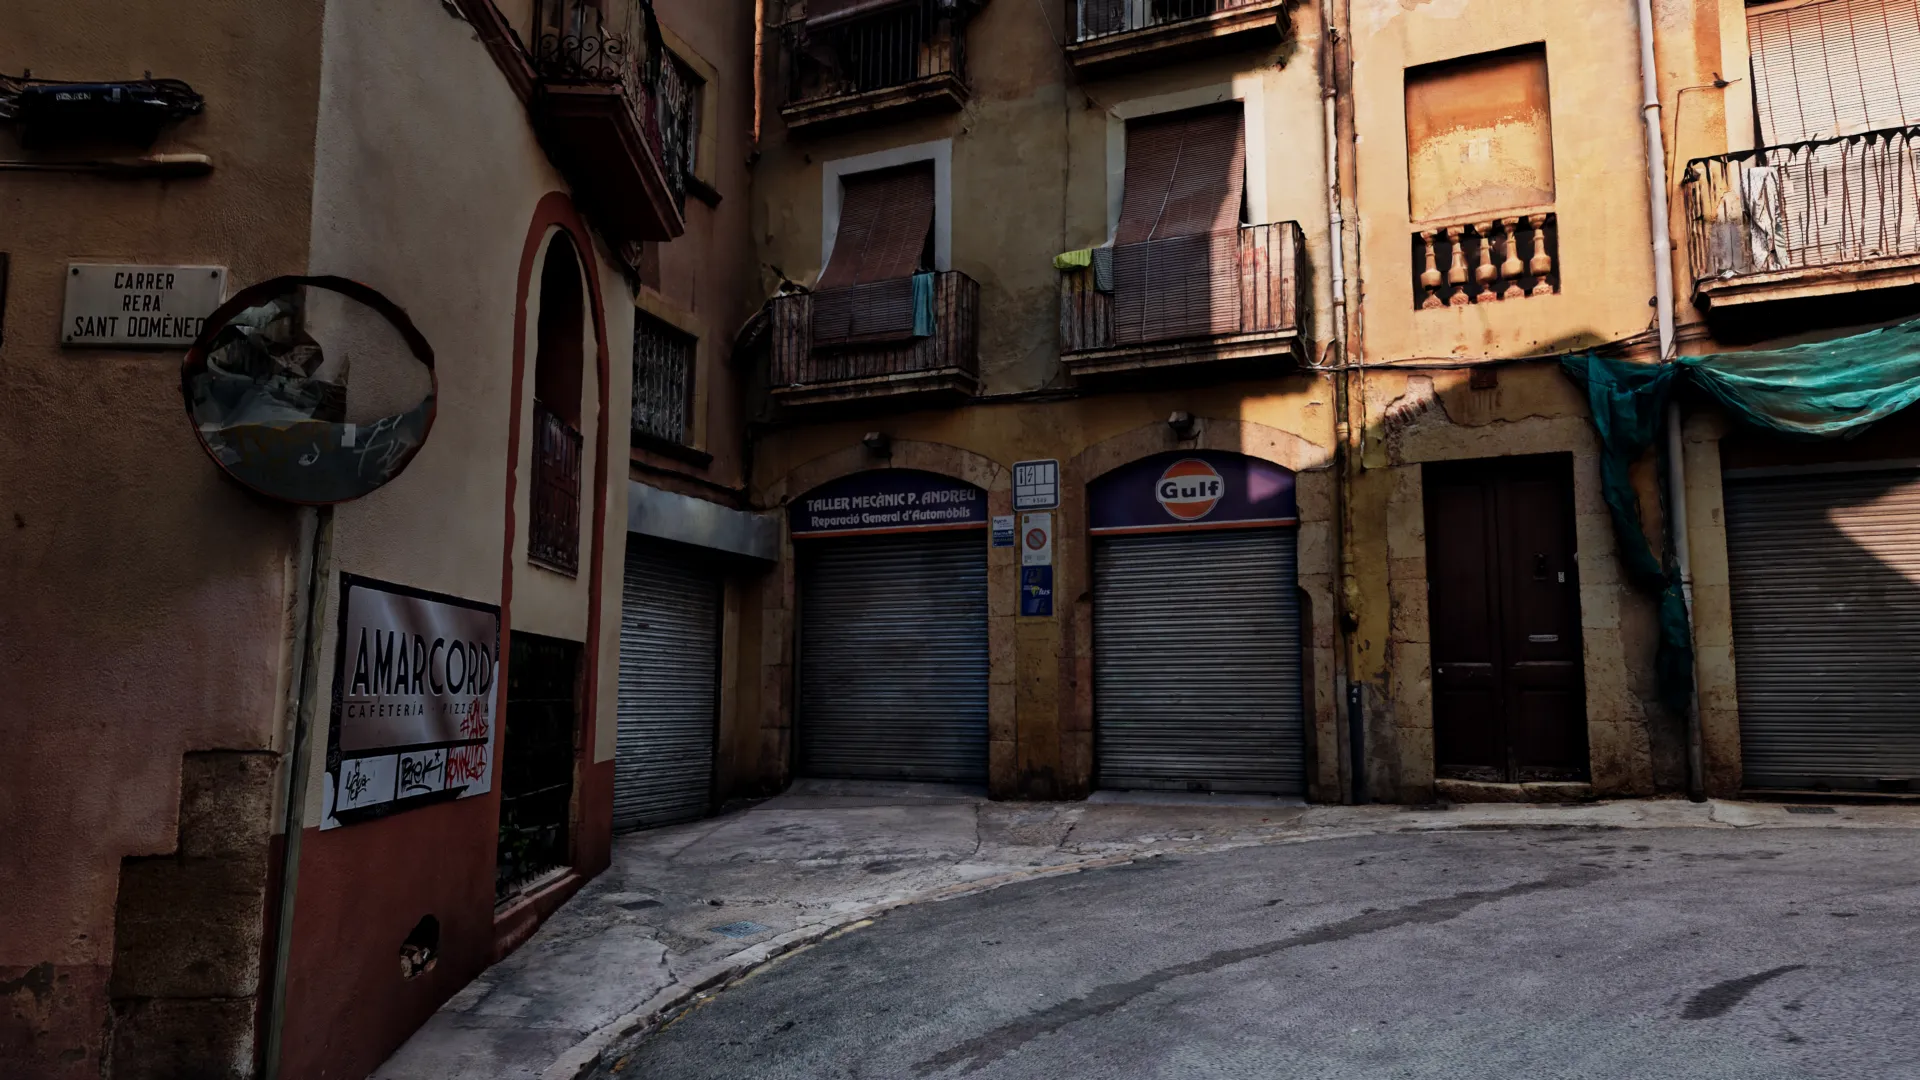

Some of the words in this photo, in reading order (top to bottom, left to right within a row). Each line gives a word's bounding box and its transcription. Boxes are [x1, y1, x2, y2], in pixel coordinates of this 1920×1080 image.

[114, 272, 175, 290] CARRER
[122, 294, 162, 312] RERA
[73, 316, 119, 338] SANT
[1159, 480, 1220, 499] Gulf
[806, 496, 850, 512] TALLER
[852, 491, 905, 508] MECÀNIC
[907, 492, 919, 505] P.
[921, 488, 976, 505] ANDREU
[811, 512, 860, 528] Reparació
[861, 511, 901, 524] General
[349, 627, 492, 696] AMARCORD
[347, 700, 425, 718] CAFETERÍA
